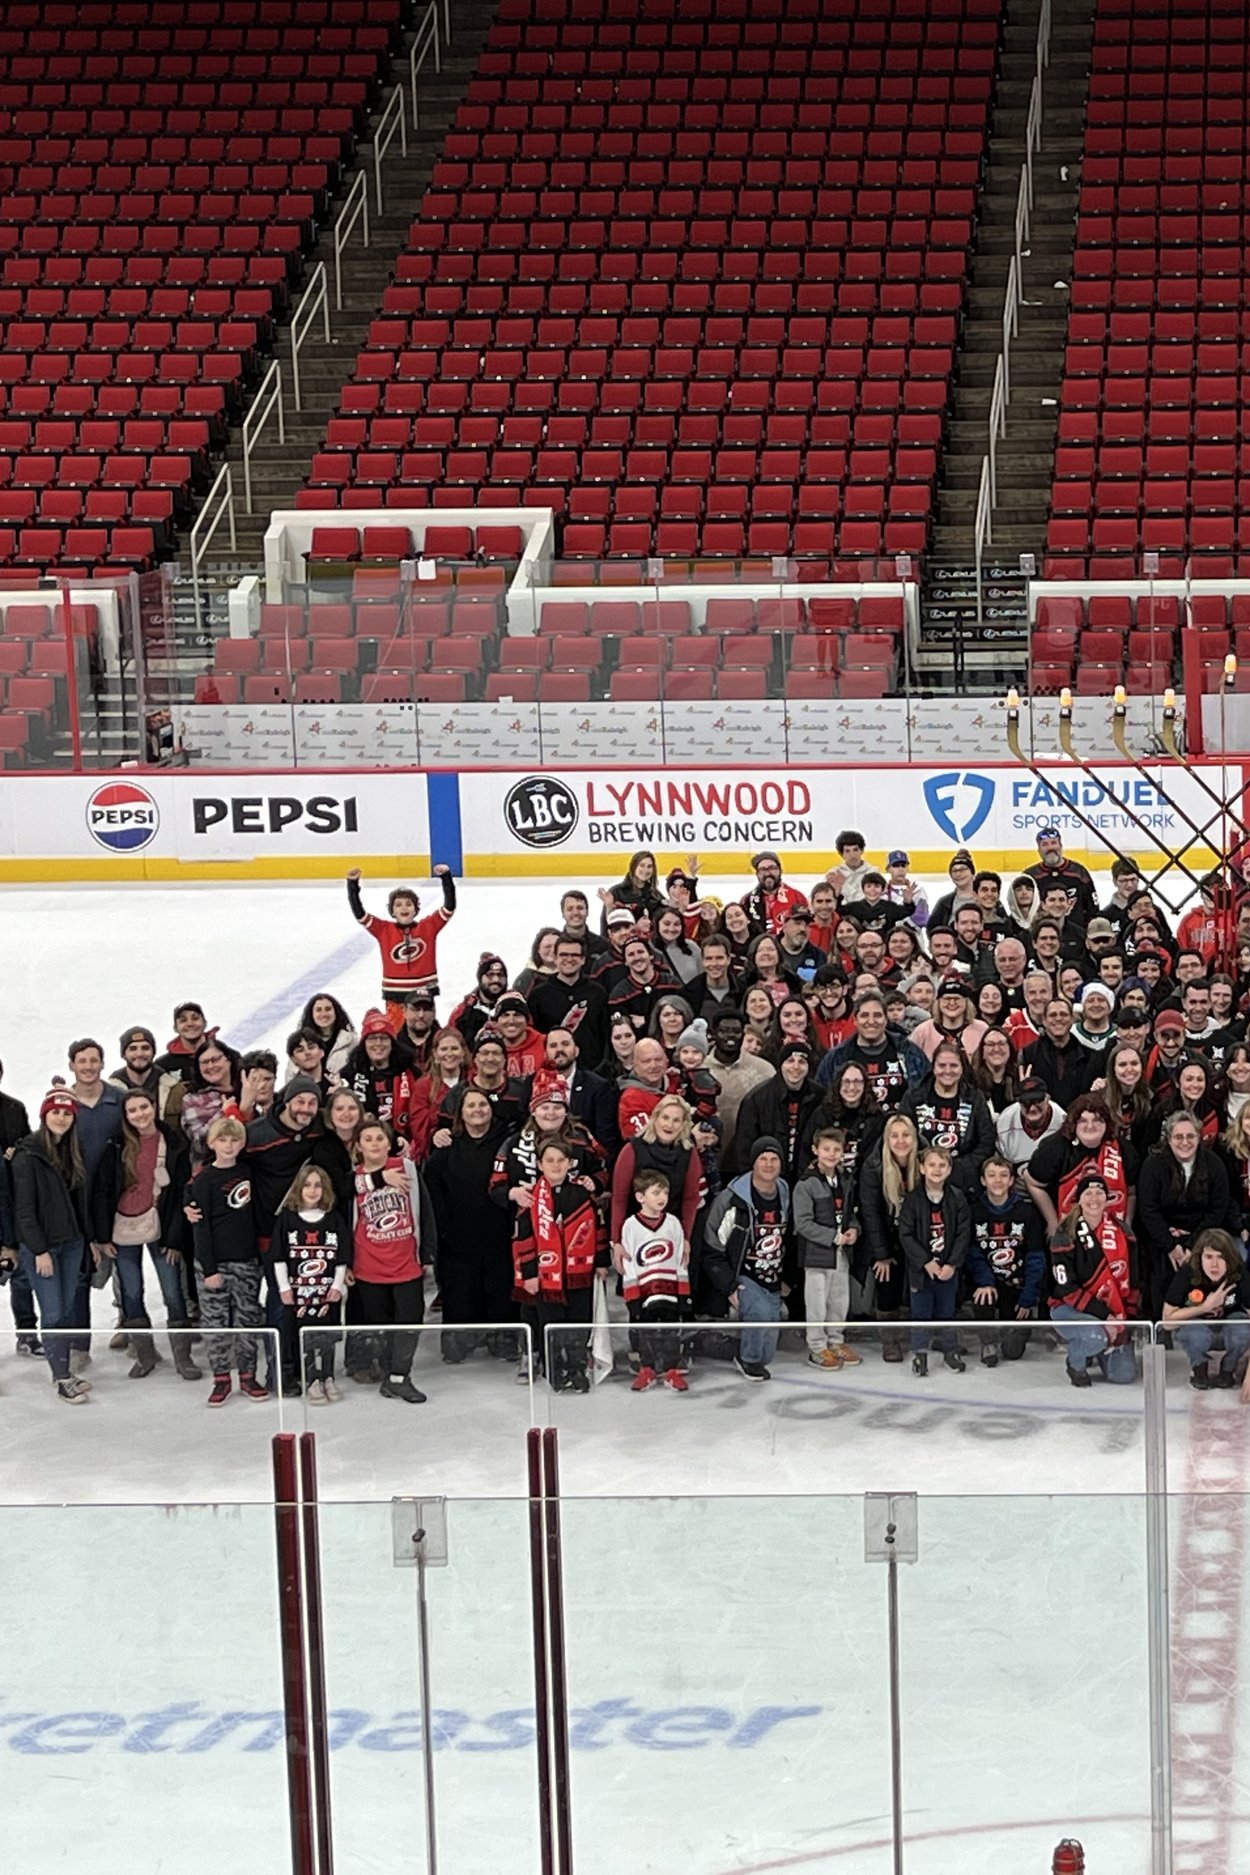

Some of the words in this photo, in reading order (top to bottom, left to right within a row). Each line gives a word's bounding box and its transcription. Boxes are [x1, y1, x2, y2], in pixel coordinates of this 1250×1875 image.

[587, 780, 811, 817] LYNNWOOD
[1013, 782, 1170, 807] FANDUEL
[91, 809, 156, 826] PEPSI
[193, 796, 358, 834] PEPSI
[510, 793, 575, 829] LBC
[1013, 813, 1082, 830] SPORTS
[1088, 813, 1175, 829] NETWORK
[588, 822, 694, 843] BREWING
[703, 821, 812, 842] CONCERN
